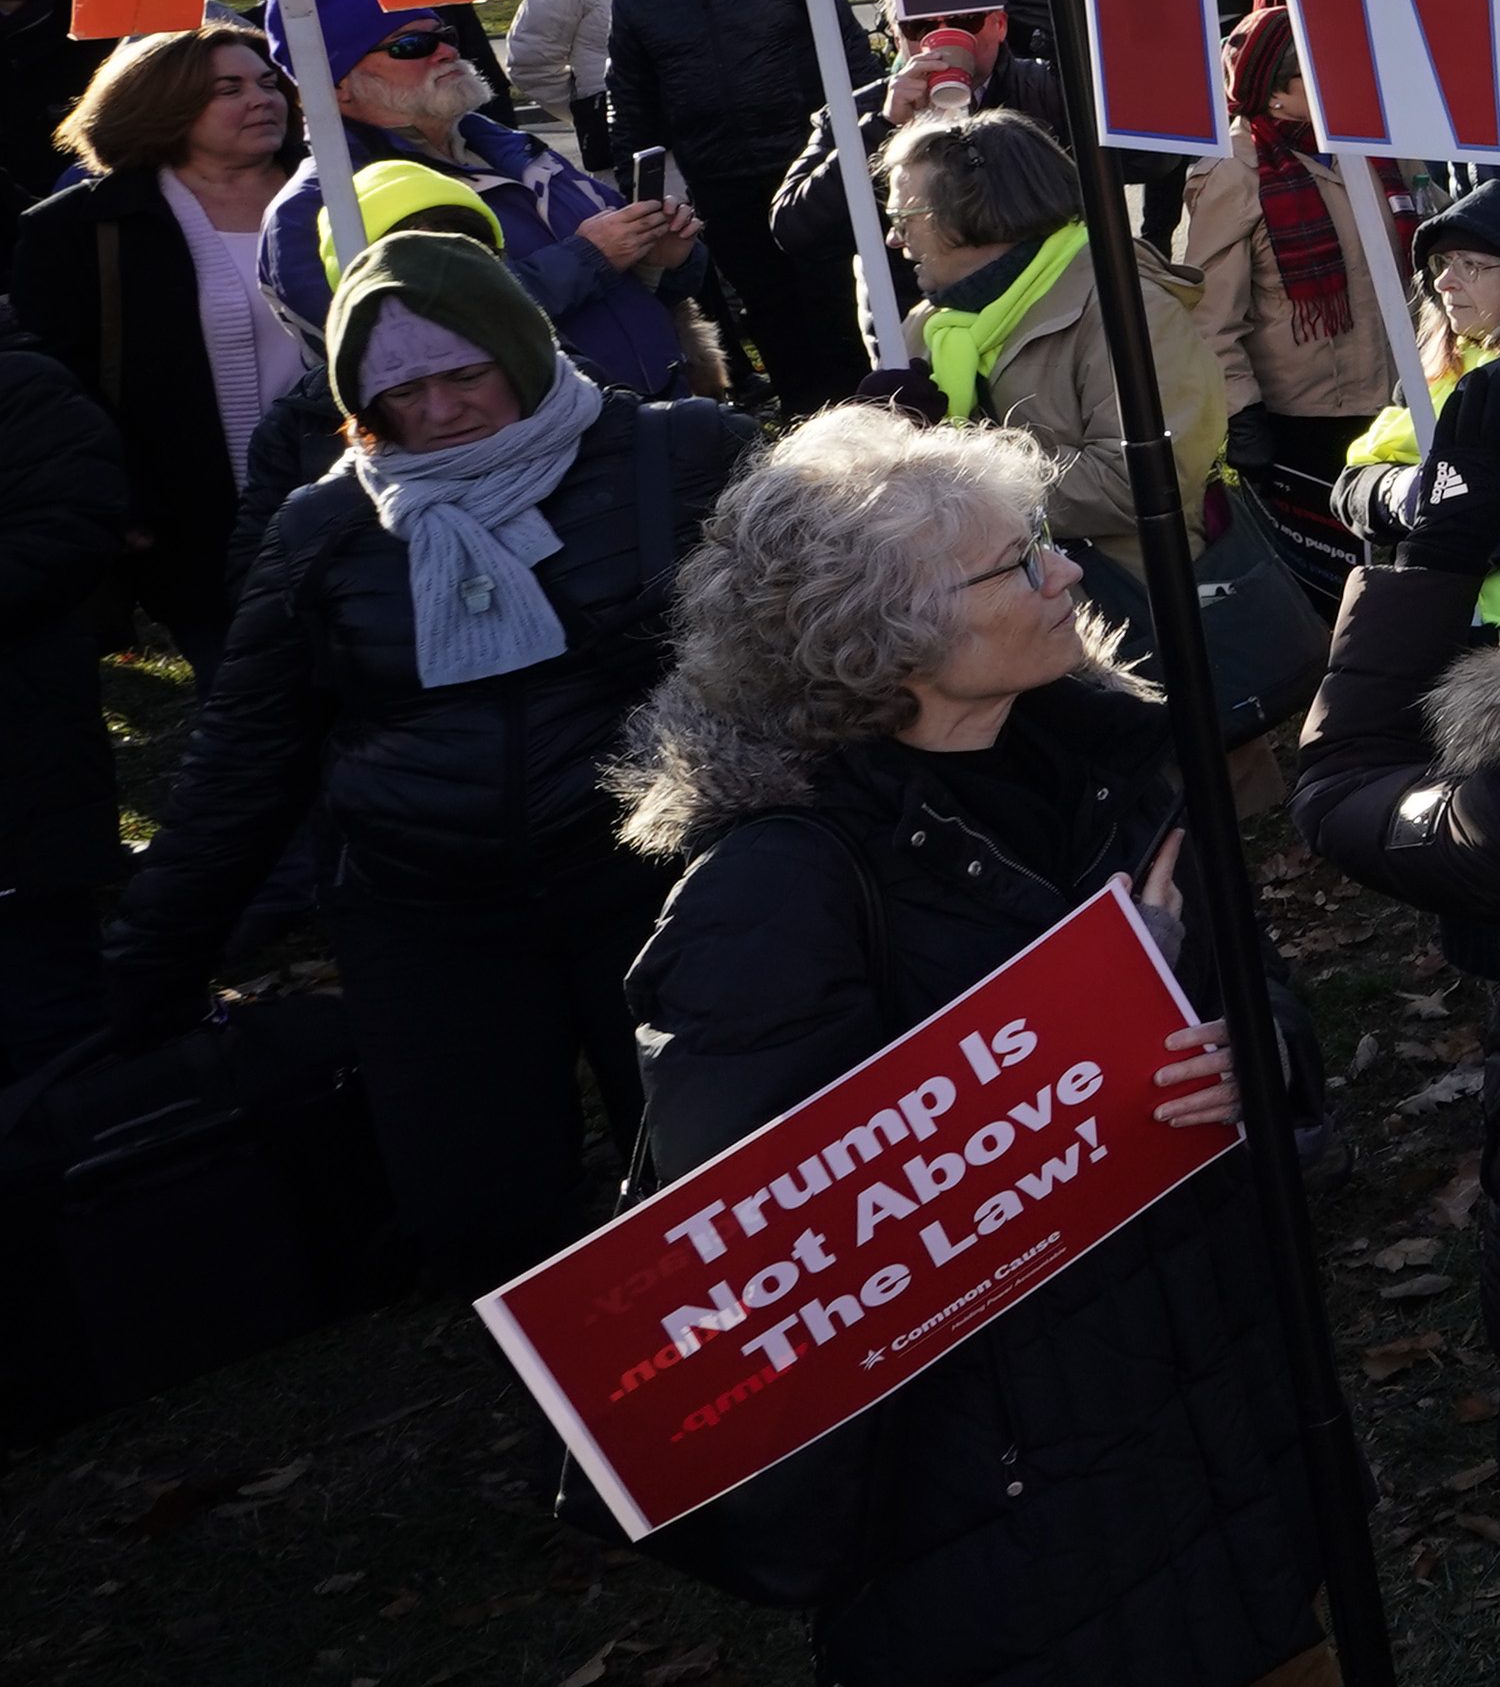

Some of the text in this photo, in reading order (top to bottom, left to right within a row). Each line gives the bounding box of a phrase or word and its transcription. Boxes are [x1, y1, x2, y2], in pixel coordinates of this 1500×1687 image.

[1306, 537, 1357, 565] Defend
[1430, 461, 1449, 505] adidas
[660, 1227, 837, 1359] Not
[856, 1061, 1104, 1248] Above
[663, 1017, 1038, 1264] Trump Is
[740, 1263, 912, 1373] The
[919, 1116, 1110, 1269] Law!
[891, 1278, 992, 1351] Common
[993, 1230, 1061, 1280] Cause
